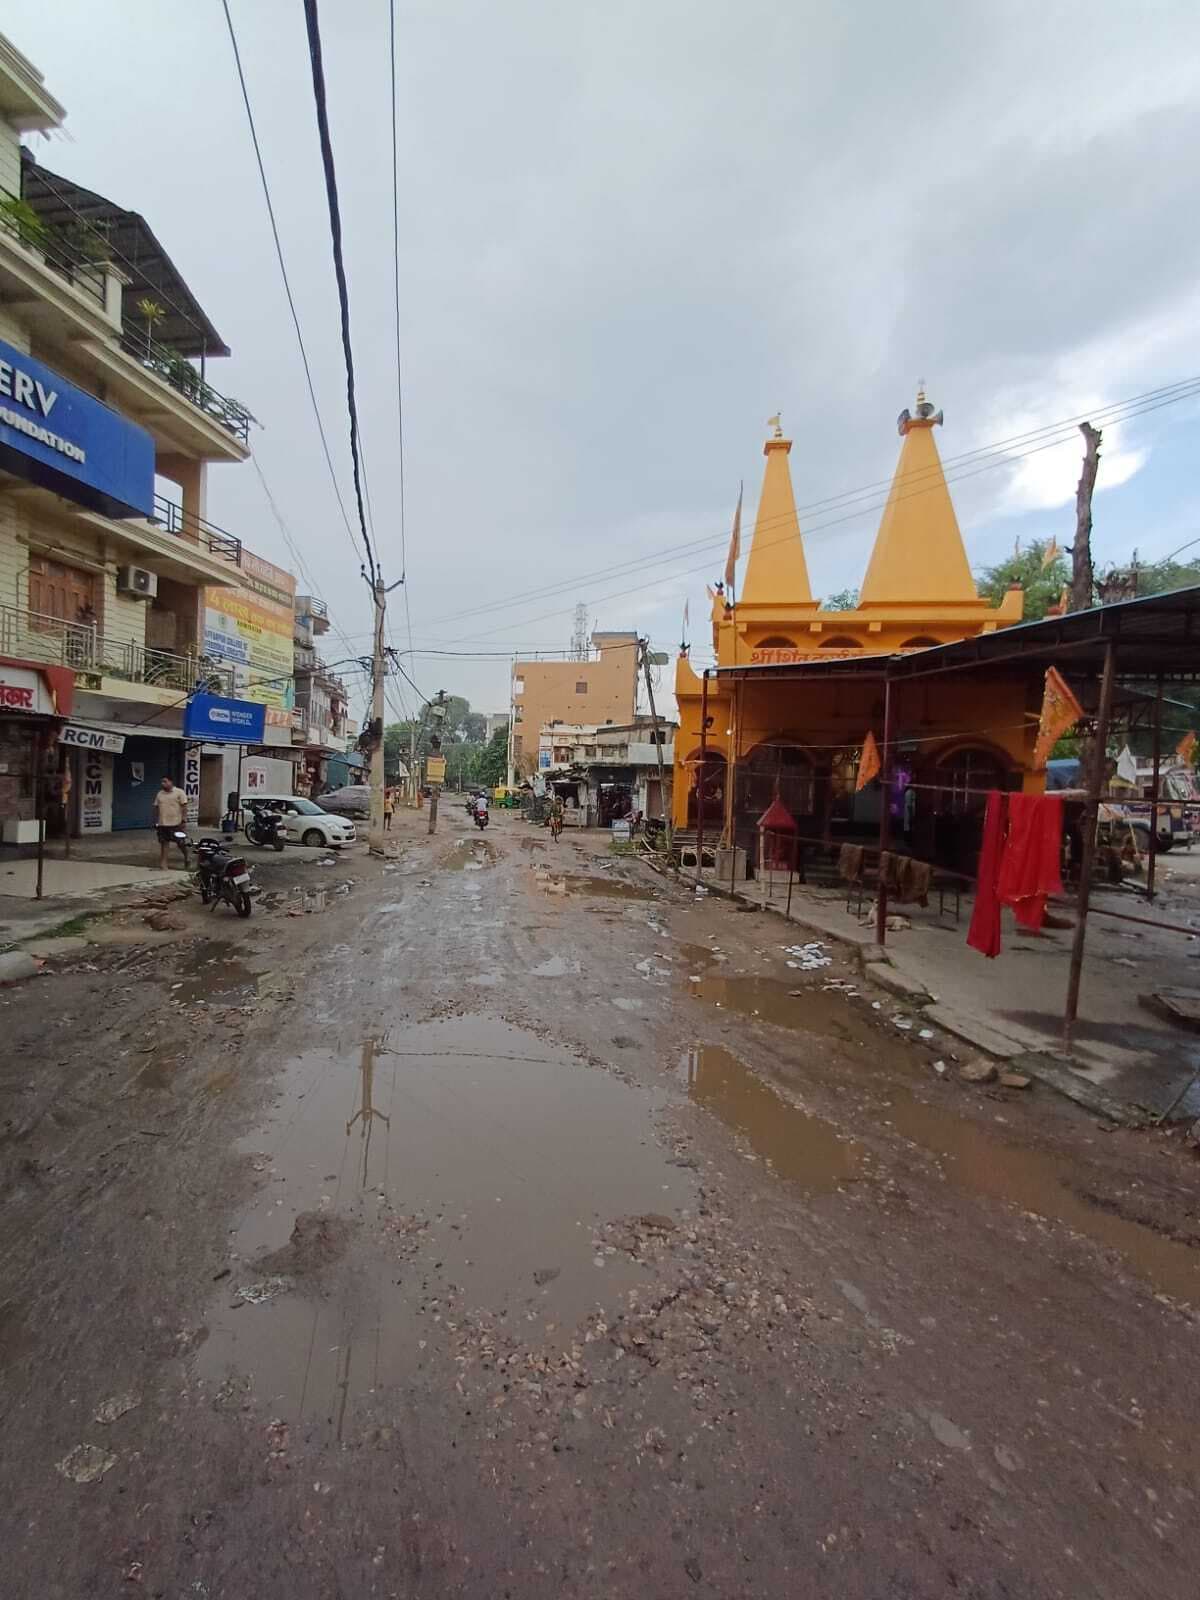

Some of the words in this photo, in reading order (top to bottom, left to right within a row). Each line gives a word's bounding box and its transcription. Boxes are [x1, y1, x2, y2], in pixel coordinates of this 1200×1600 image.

[63, 728, 105, 747] RCM
[85, 751, 103, 795] RCM
[185, 759, 199, 796] RCM
